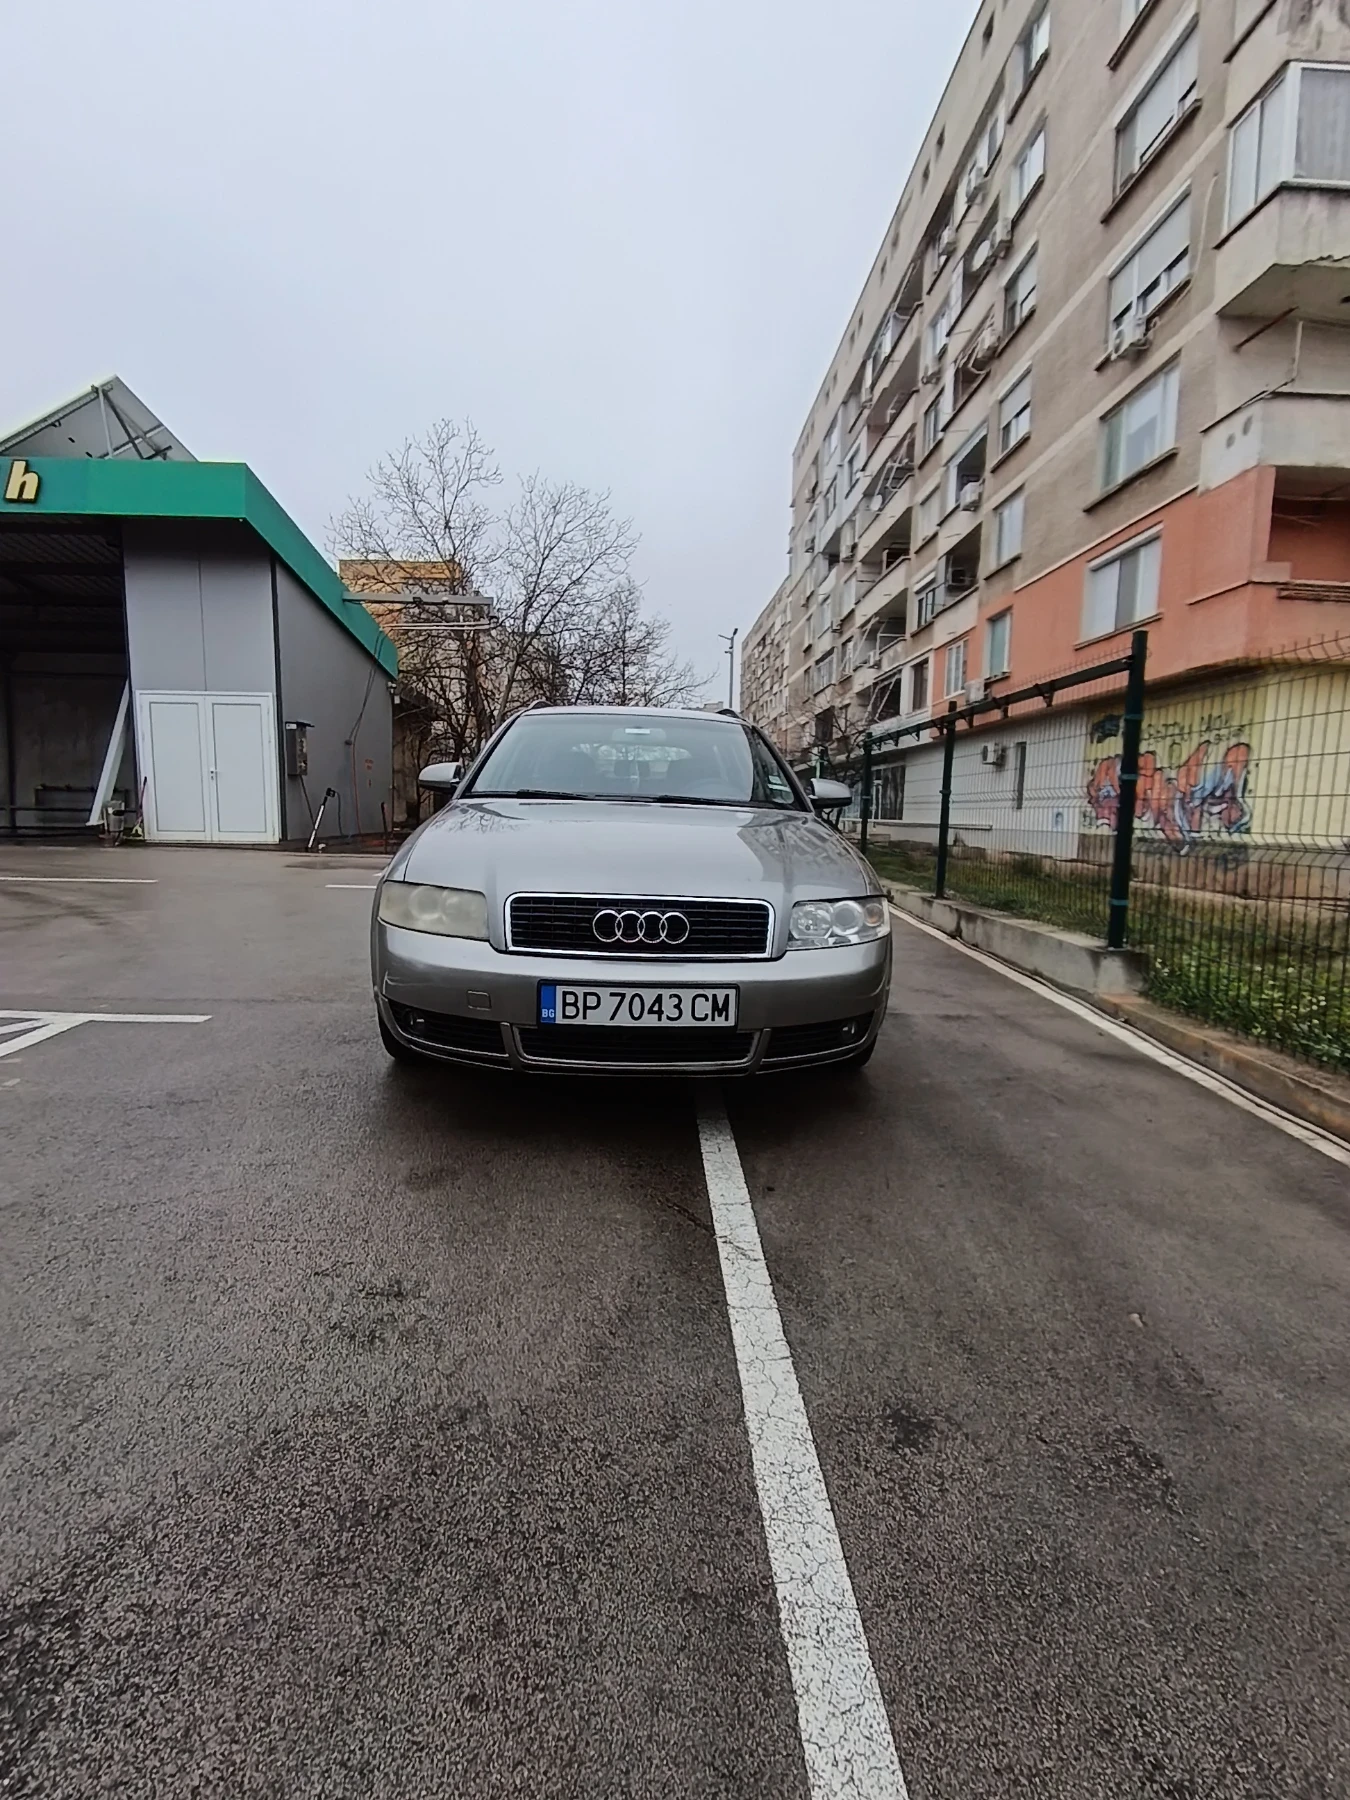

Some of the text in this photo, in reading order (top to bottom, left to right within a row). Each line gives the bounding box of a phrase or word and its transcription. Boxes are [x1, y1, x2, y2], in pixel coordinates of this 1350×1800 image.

[4, 459, 40, 502] h
[541, 1008, 555, 1018] BG
[561, 990, 730, 1022] BP 7043 CM
